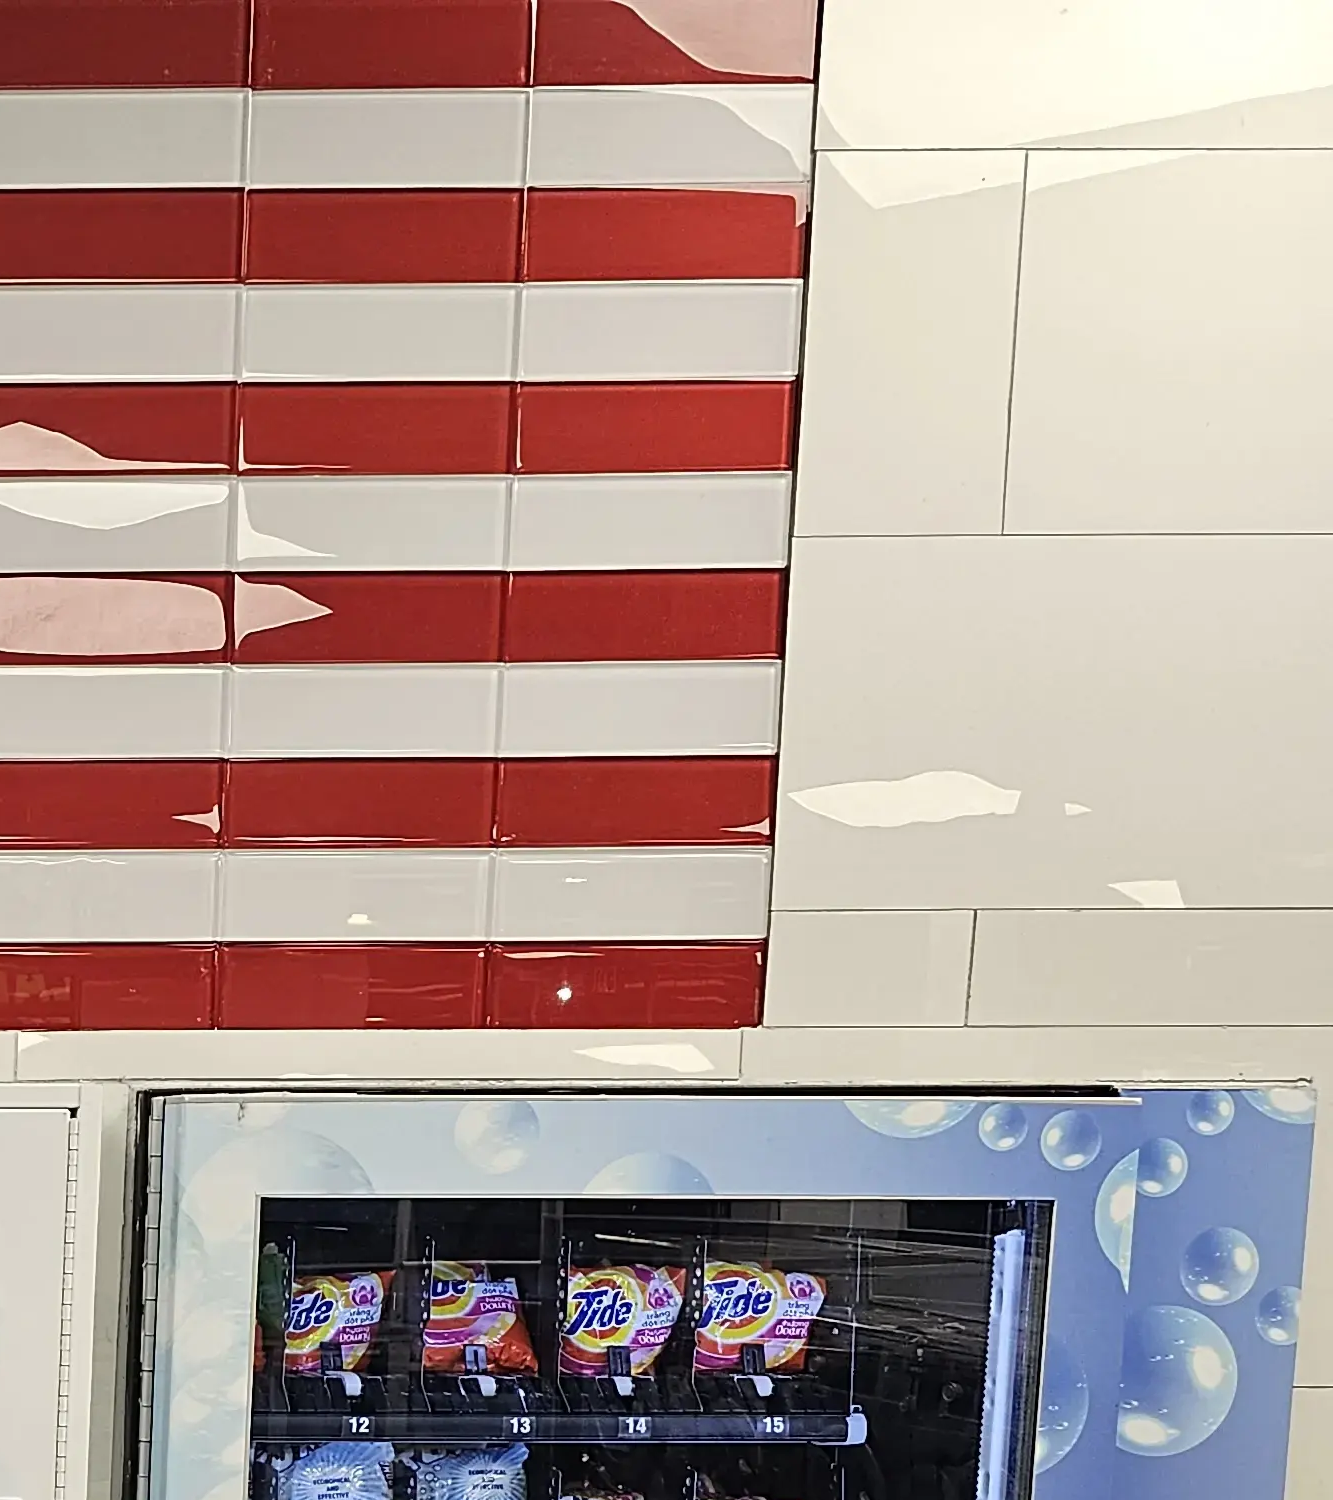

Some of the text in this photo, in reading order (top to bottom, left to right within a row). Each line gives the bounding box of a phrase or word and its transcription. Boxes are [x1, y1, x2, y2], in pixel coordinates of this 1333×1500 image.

[564, 1288, 635, 1336] Tide
[697, 1277, 775, 1330] Tide
[348, 1416, 370, 1433] 12
[509, 1416, 531, 1434] 13
[625, 1416, 646, 1434] 14
[762, 1416, 785, 1434] 15
